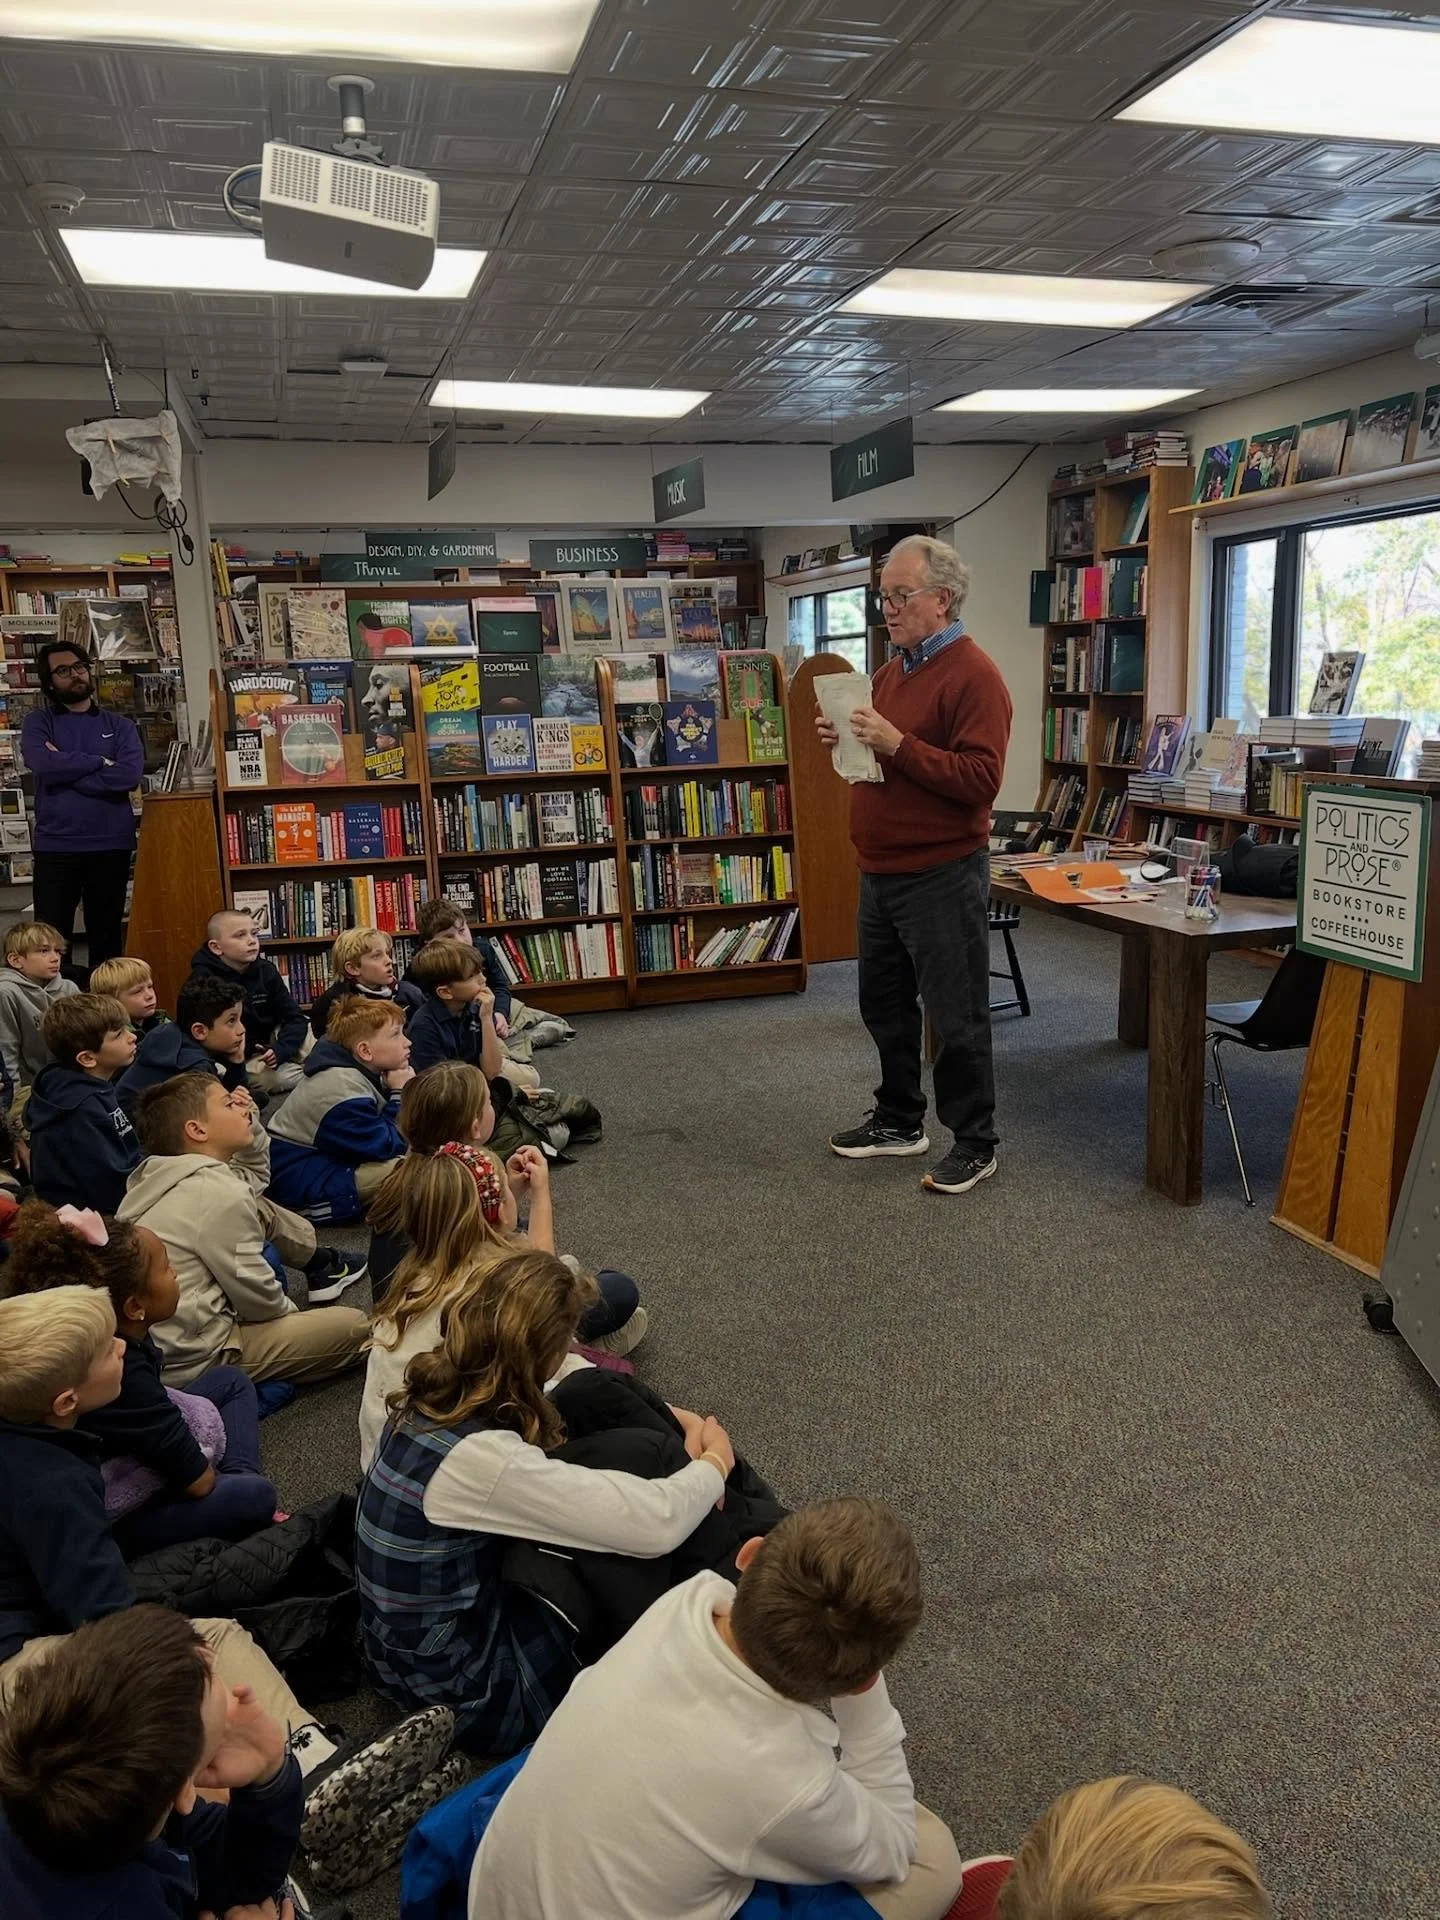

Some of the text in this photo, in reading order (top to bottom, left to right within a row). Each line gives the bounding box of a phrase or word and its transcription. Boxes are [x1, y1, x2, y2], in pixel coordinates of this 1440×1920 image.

[857, 447, 879, 479] FILM
[666, 477, 687, 507] MUSIC
[368, 544, 495, 557] DESIGN, DIY, & GARDENING
[556, 547, 620, 563] BUSINESS
[380, 615, 408, 624] RIGHTS
[483, 663, 531, 672] FOOTBALL
[729, 662, 770, 671] TENNIS
[229, 676, 297, 693] HARDCOURT
[311, 682, 326, 690] THE
[731, 699, 770, 709] COURT
[281, 713, 337, 725] BASKETBALL
[496, 720, 518, 731] PLAY
[754, 749, 765, 757] THE
[493, 755, 528, 768] HARDER
[240, 764, 261, 774] NBA
[290, 805, 306, 813] LAST
[1315, 806, 1410, 850] POLITICS
[1350, 842, 1369, 853] AND
[446, 883, 470, 893] THE END
[450, 892, 475, 902] COLLEGE
[1313, 888, 1407, 920] BOOKSTORE
[1311, 917, 1404, 950] COFFEEHOUSE
